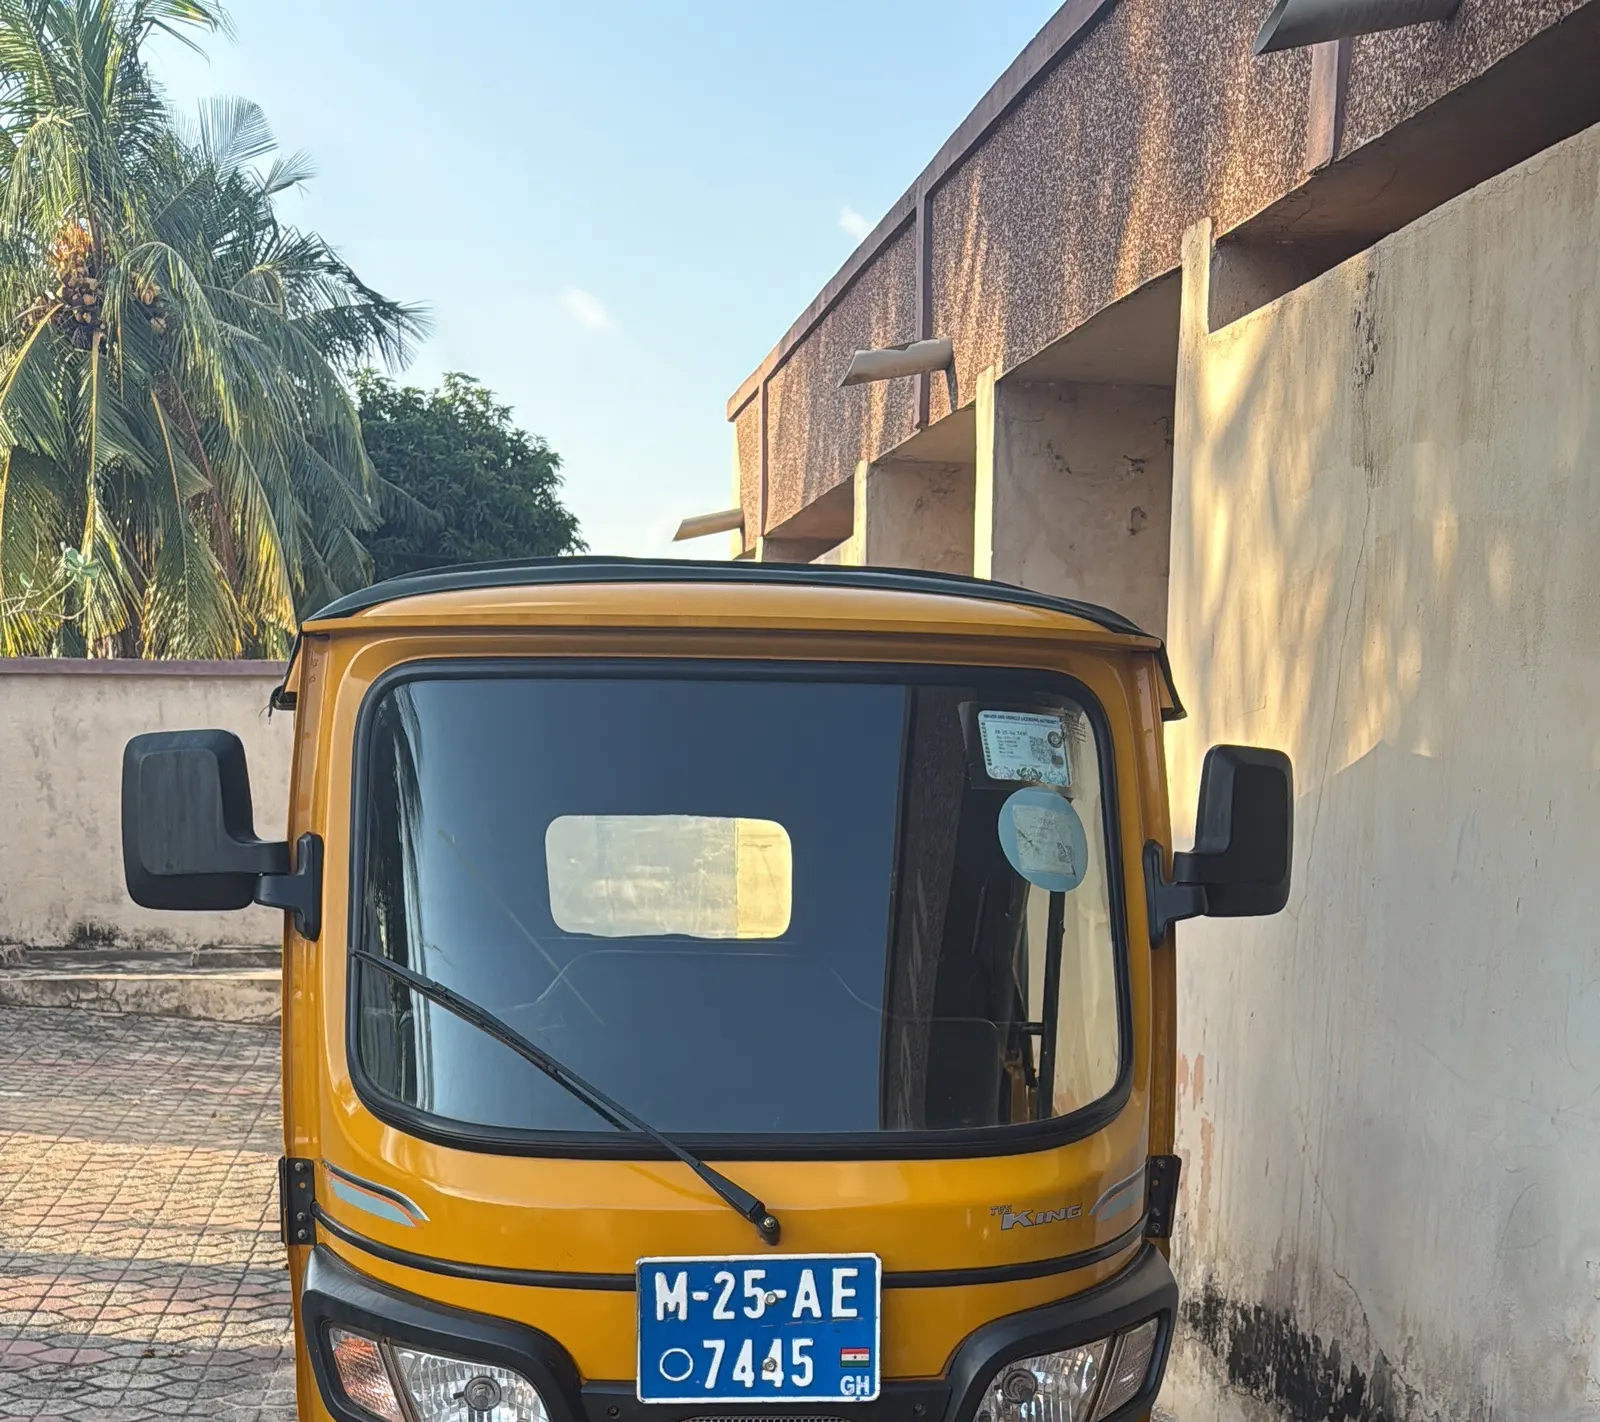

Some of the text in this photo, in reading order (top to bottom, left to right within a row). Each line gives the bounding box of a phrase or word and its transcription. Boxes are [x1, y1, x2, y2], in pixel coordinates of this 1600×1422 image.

[1001, 1203, 1083, 1231] KING
[655, 1268, 859, 1321] M-25-AE
[703, 1338, 814, 1389] 7445
[840, 1375, 870, 1396] GH
